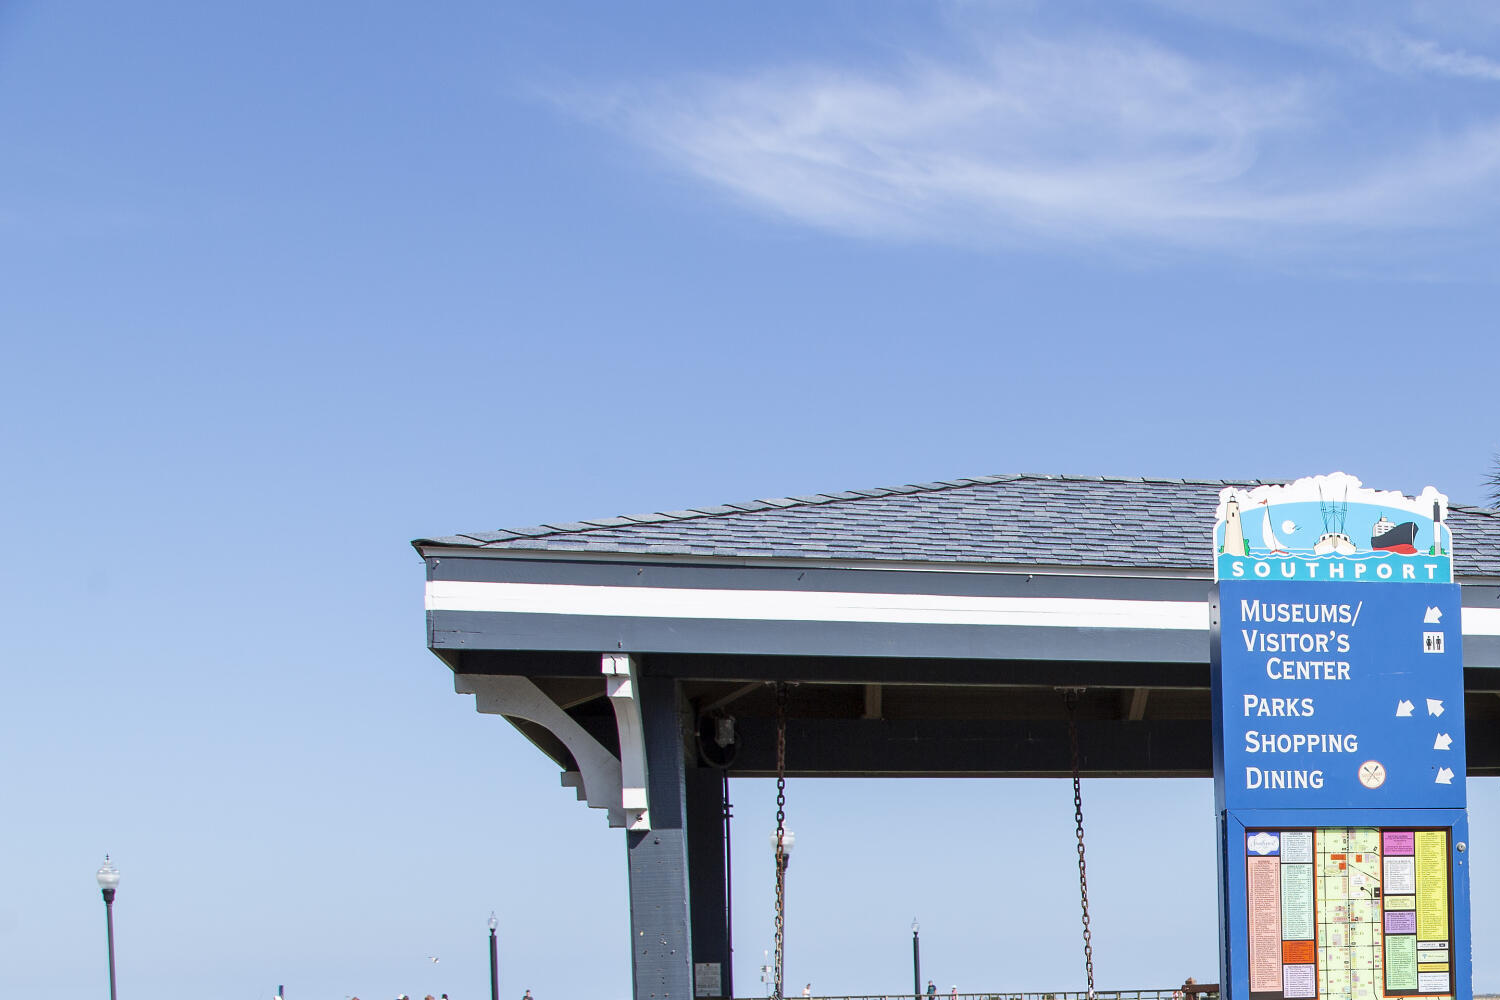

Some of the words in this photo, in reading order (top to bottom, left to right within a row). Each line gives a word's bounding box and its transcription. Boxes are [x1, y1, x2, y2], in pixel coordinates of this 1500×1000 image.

[1231, 561, 1438, 580] SOUTHPORT
[1240, 599, 1363, 627] MUSEUMS/
[1241, 629, 1351, 653] VISITOR'S
[1266, 657, 1351, 680] CENTER
[1243, 694, 1315, 717] PARKS
[1245, 731, 1358, 753] SHOPPING
[1246, 767, 1325, 789] DINING
